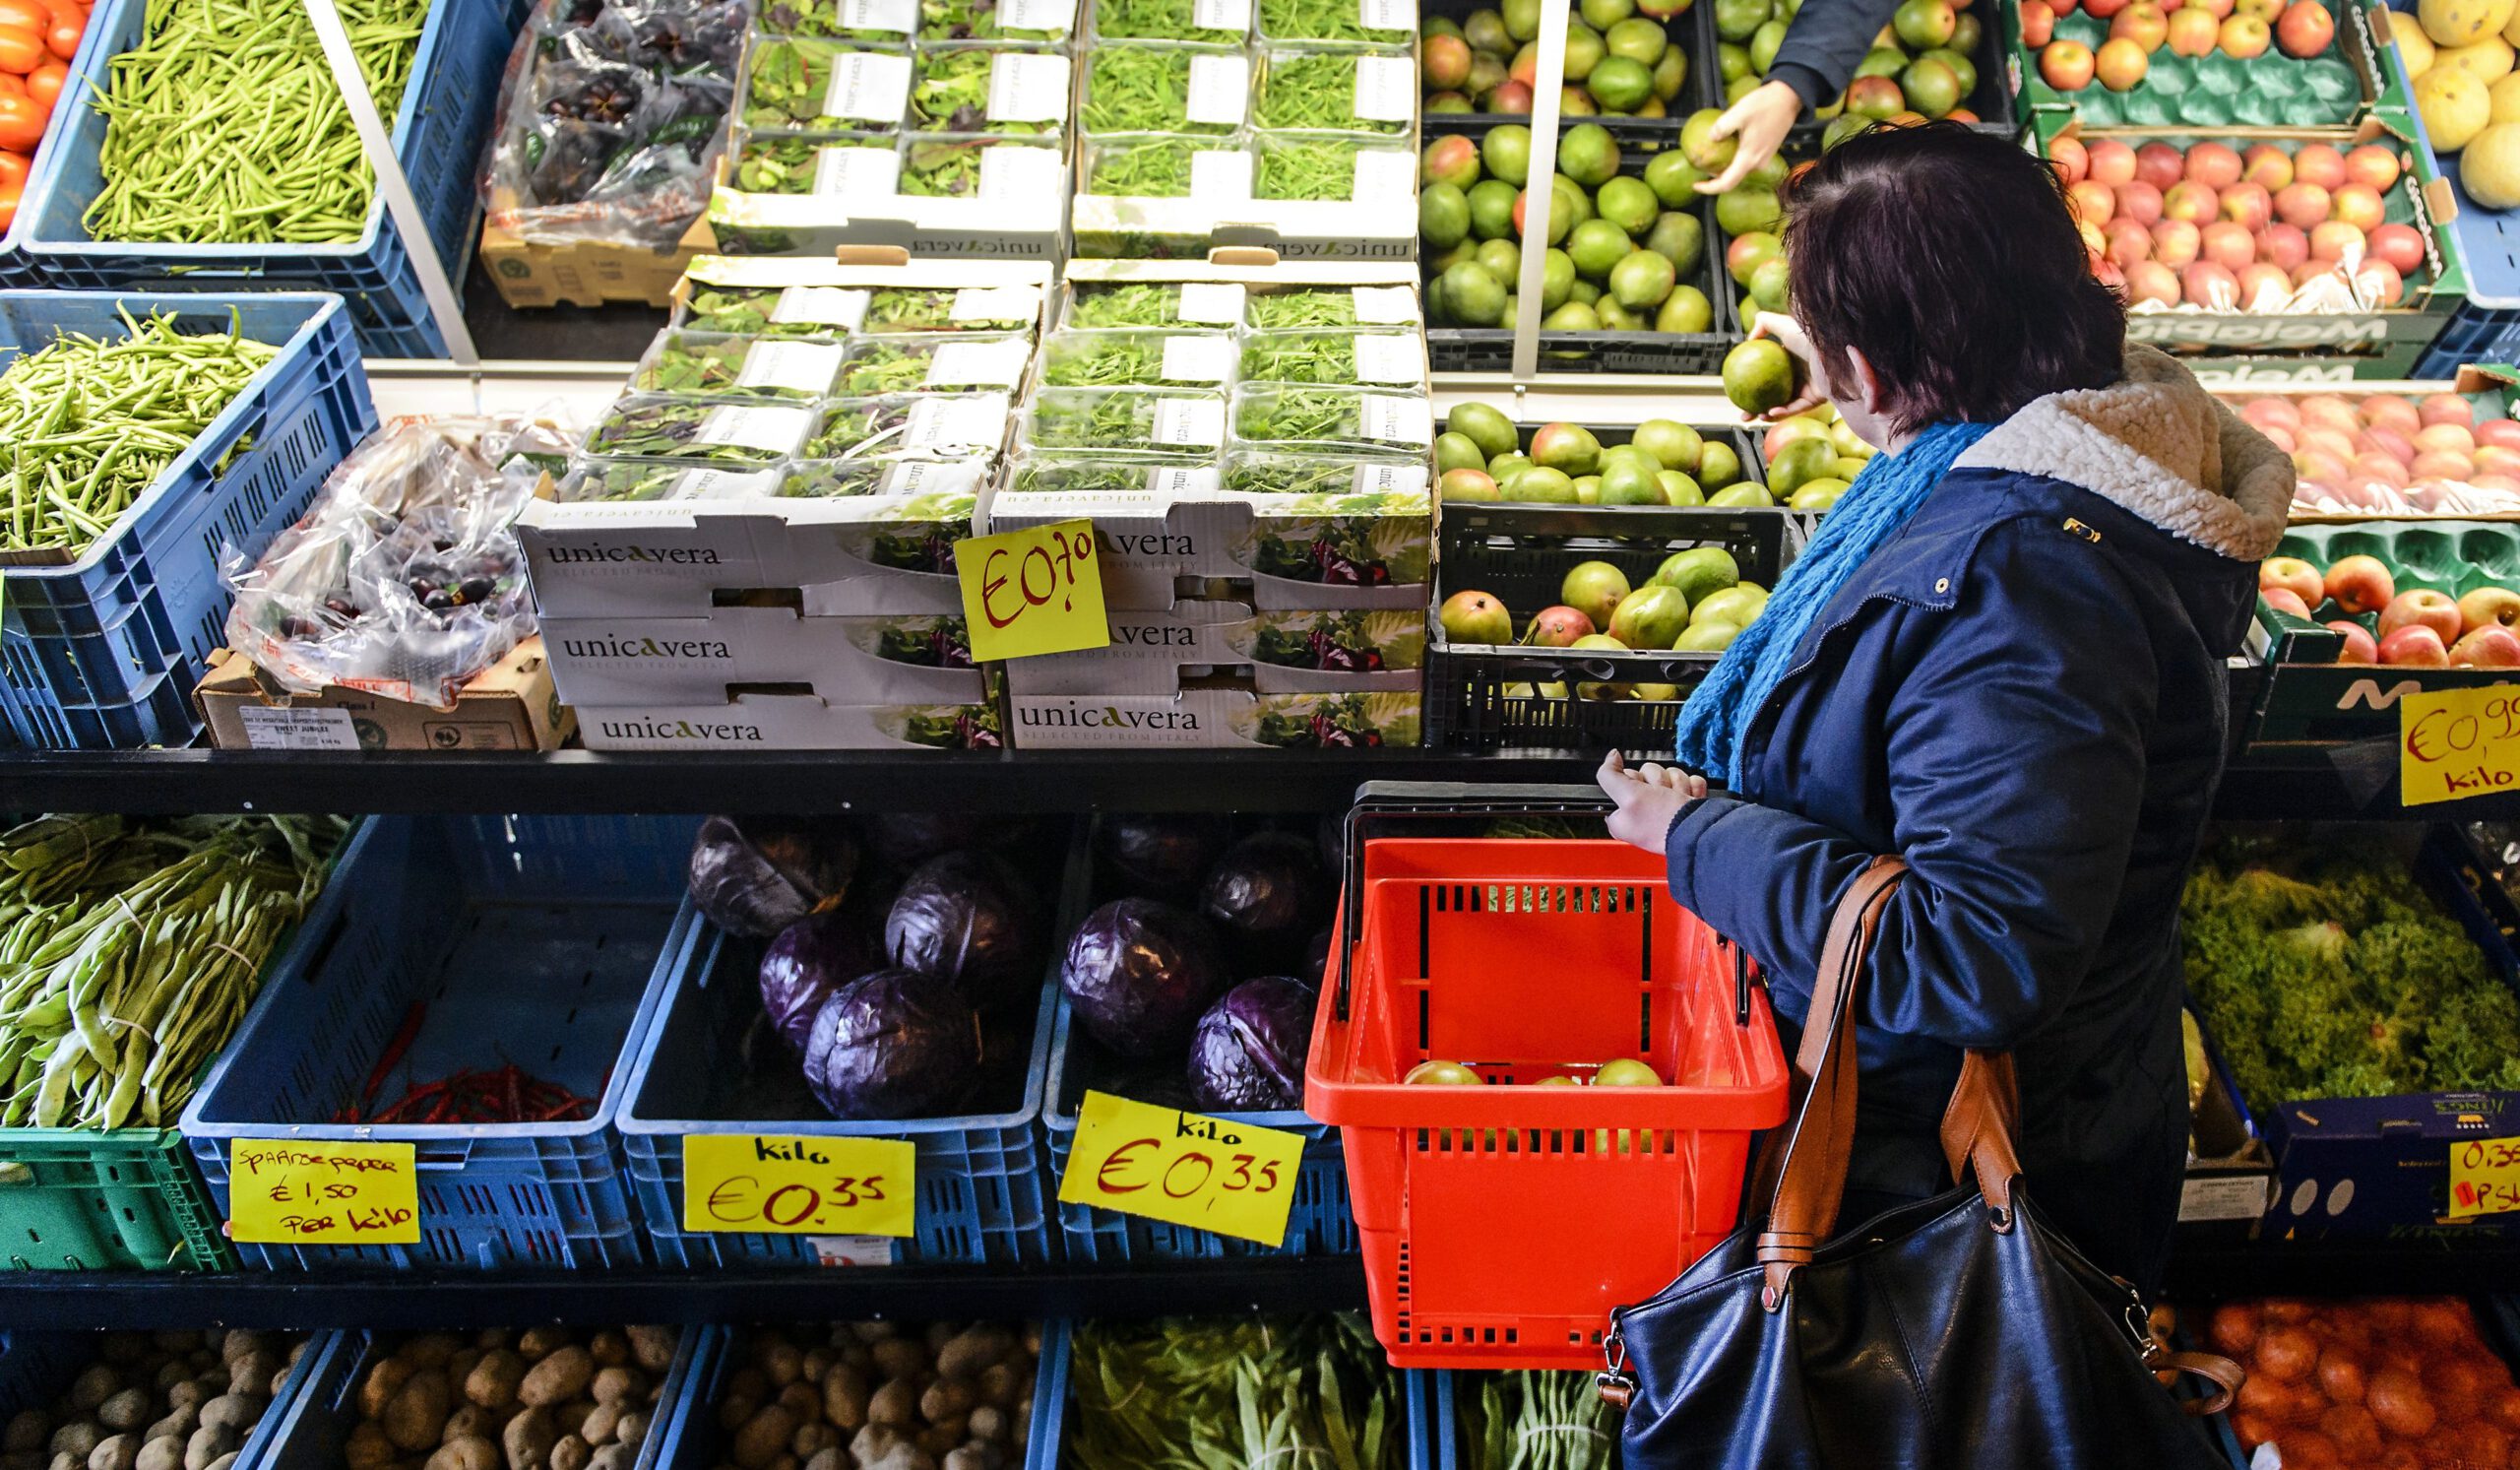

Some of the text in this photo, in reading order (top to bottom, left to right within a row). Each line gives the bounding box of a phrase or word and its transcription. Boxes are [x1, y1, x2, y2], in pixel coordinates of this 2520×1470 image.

[547, 542, 723, 566] unicavera
[563, 632, 733, 659] unicavera
[600, 715, 765, 742] unicavera
[1018, 700, 1202, 731] unicavera
[2443, 765, 2514, 795] kilo
[346, 1207, 411, 1233] kilo
